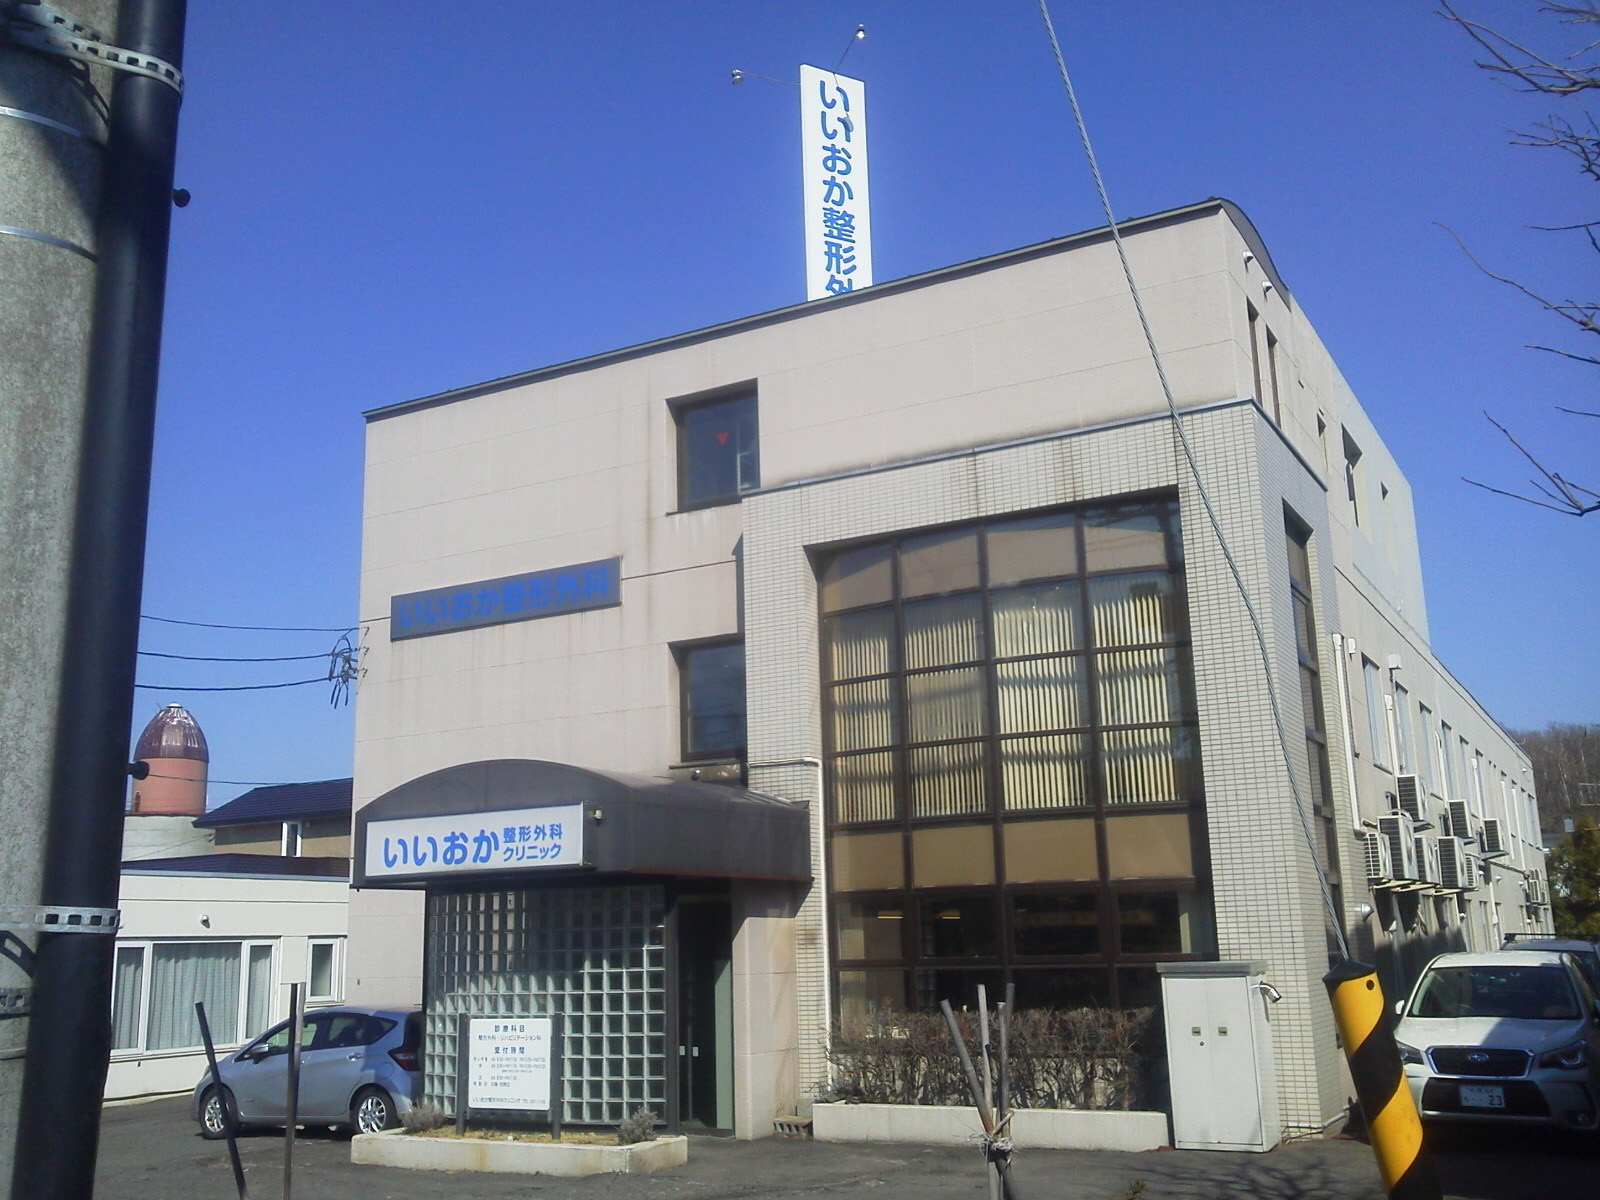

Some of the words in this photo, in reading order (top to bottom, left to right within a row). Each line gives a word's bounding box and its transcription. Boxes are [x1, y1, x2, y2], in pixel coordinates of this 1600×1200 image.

[399, 567, 609, 628] いいおか整形外科
[503, 823, 563, 844] 整形外科
[384, 829, 500, 868] いいおか
[503, 843, 562, 862] クリニック
[494, 1046, 525, 1054] 受付時間
